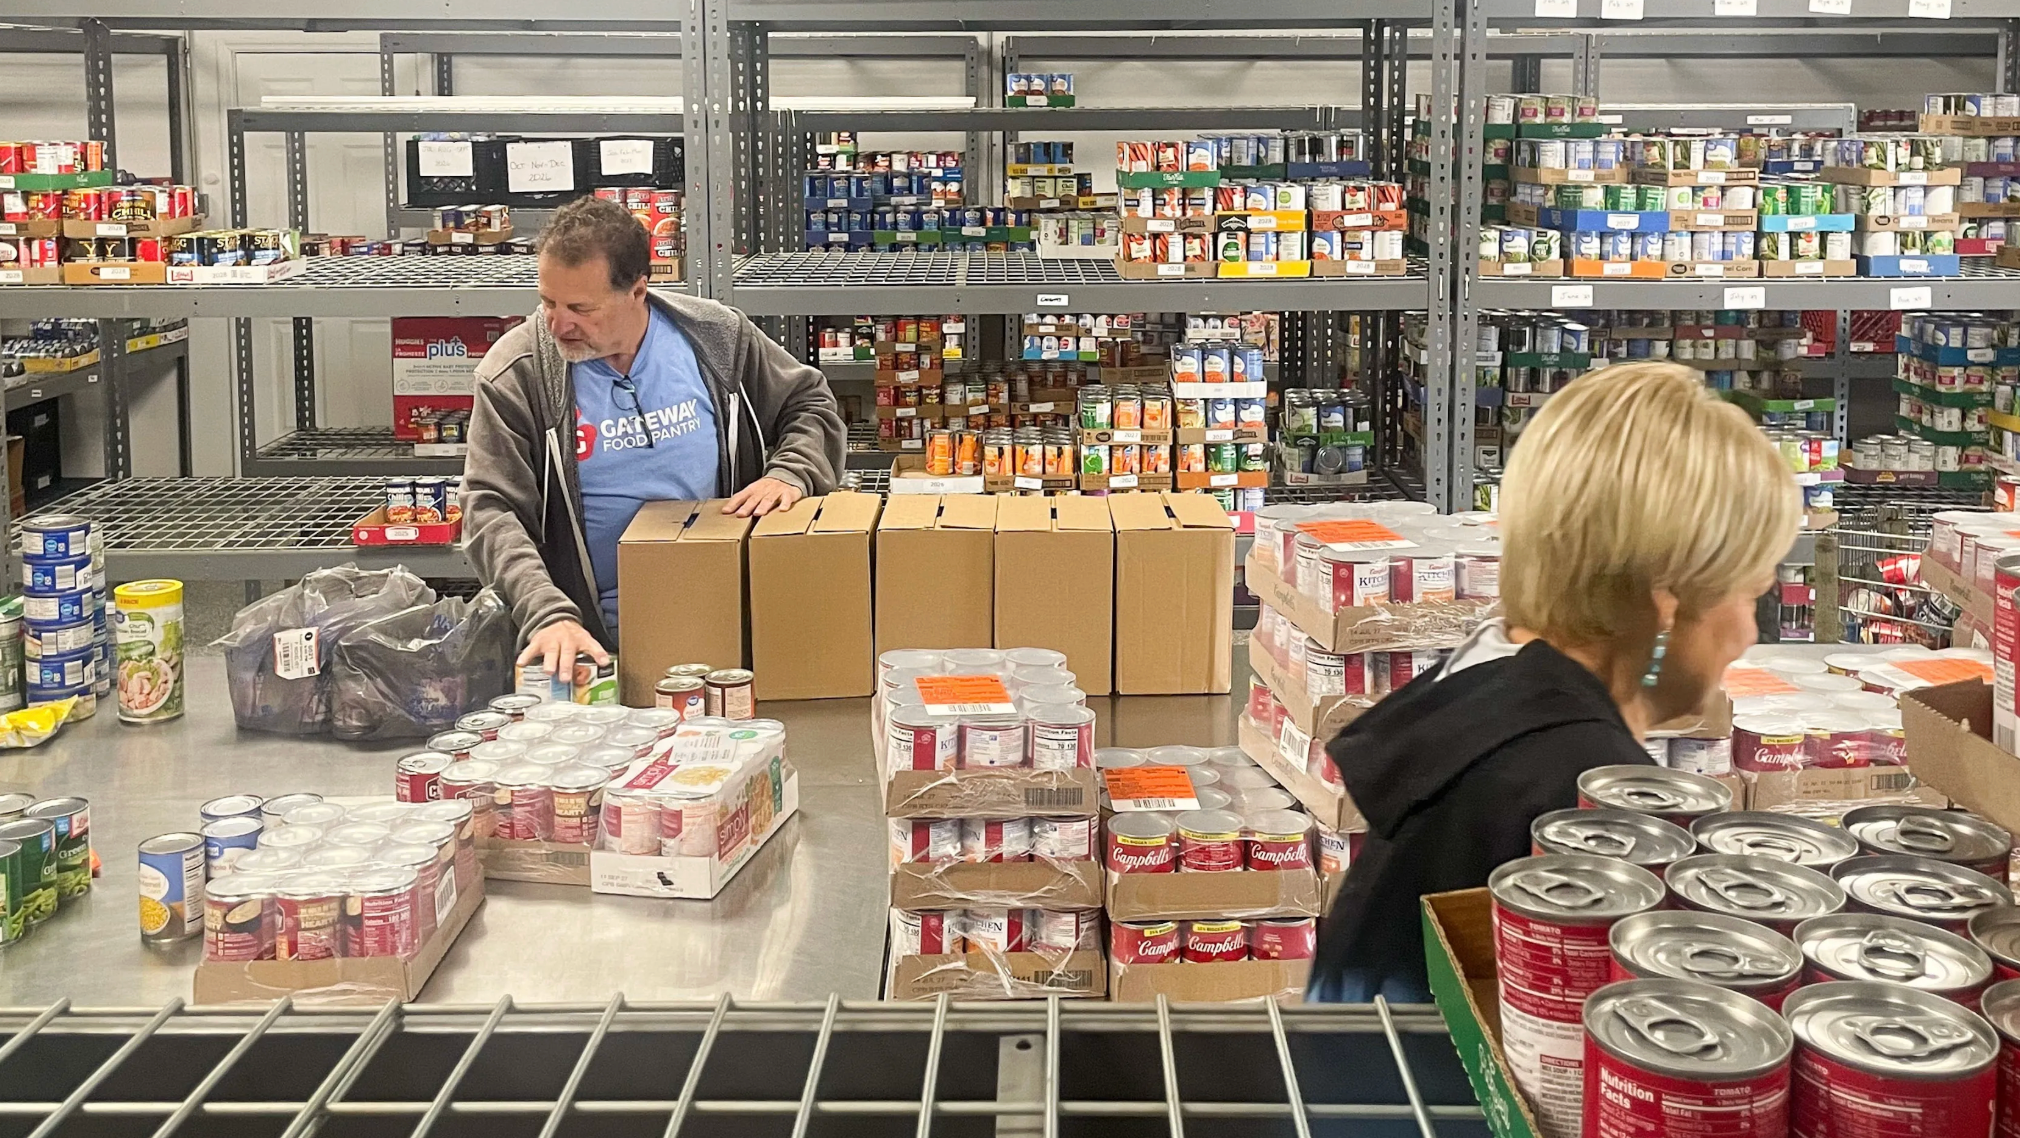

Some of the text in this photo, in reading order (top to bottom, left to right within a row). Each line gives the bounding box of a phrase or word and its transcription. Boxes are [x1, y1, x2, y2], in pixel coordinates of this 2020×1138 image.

[600, 399, 697, 438] GATEWAY
[602, 416, 701, 452] FOOD PANTRY
[1112, 846, 1169, 867] Campbell's
[1250, 841, 1307, 864] Campbell's
[1529, 921, 1561, 935] TOMATO
[1187, 932, 1244, 953] Campbell's
[1601, 1066, 1655, 1103] Nutrition
[1601, 1081, 1631, 1110] Facts
[1714, 1085, 1751, 1096] TOMATO
[1662, 1104, 1692, 1118] Total Fat
